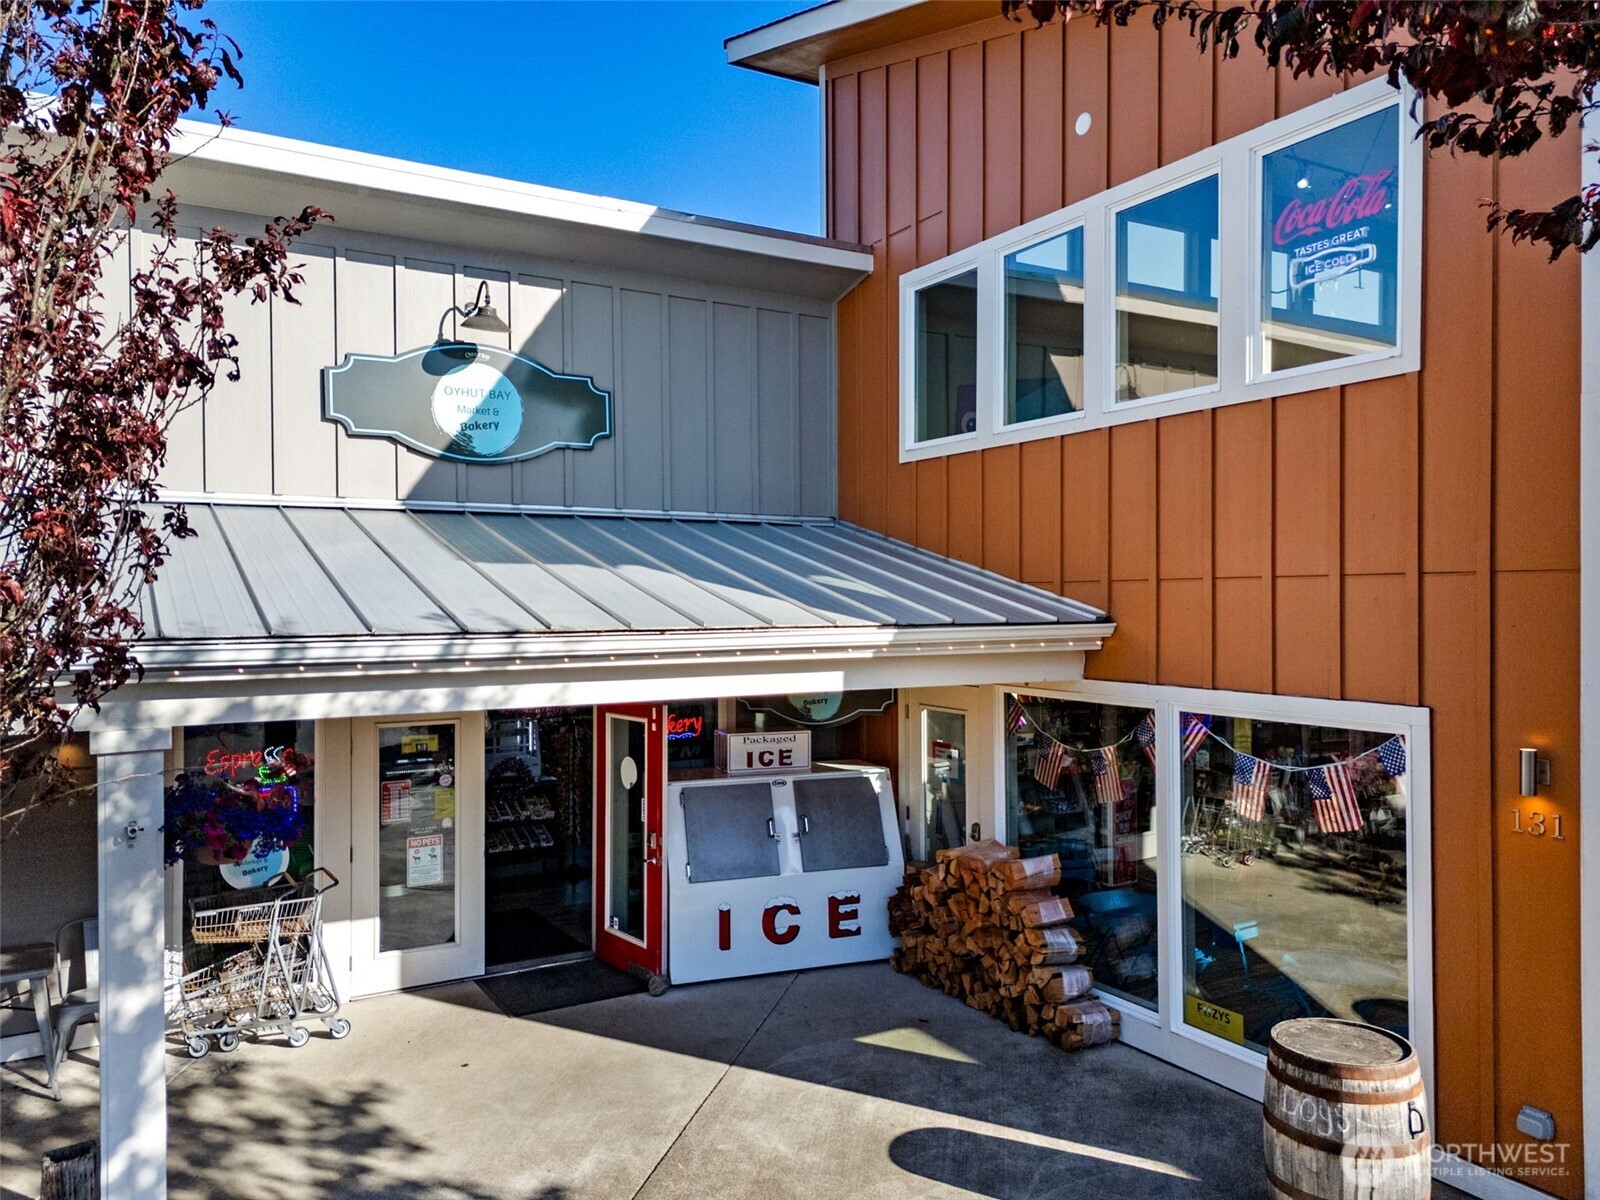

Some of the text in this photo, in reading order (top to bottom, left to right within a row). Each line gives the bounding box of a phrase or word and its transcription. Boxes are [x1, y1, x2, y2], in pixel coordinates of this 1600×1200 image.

[1294, 226, 1370, 258] TASTES GREAT
[1305, 260, 1322, 276] ICE
[444, 386, 511, 400] OYHUT BAY
[457, 405, 499, 416] Market &
[460, 421, 499, 431] Bakery
[742, 735, 797, 744] Packaged
[746, 749, 793, 768] ICE
[1511, 808, 1565, 839] 131
[410, 837, 440, 847] NO PETS
[242, 864, 268, 876] Bakery
[718, 890, 861, 951] ICE
